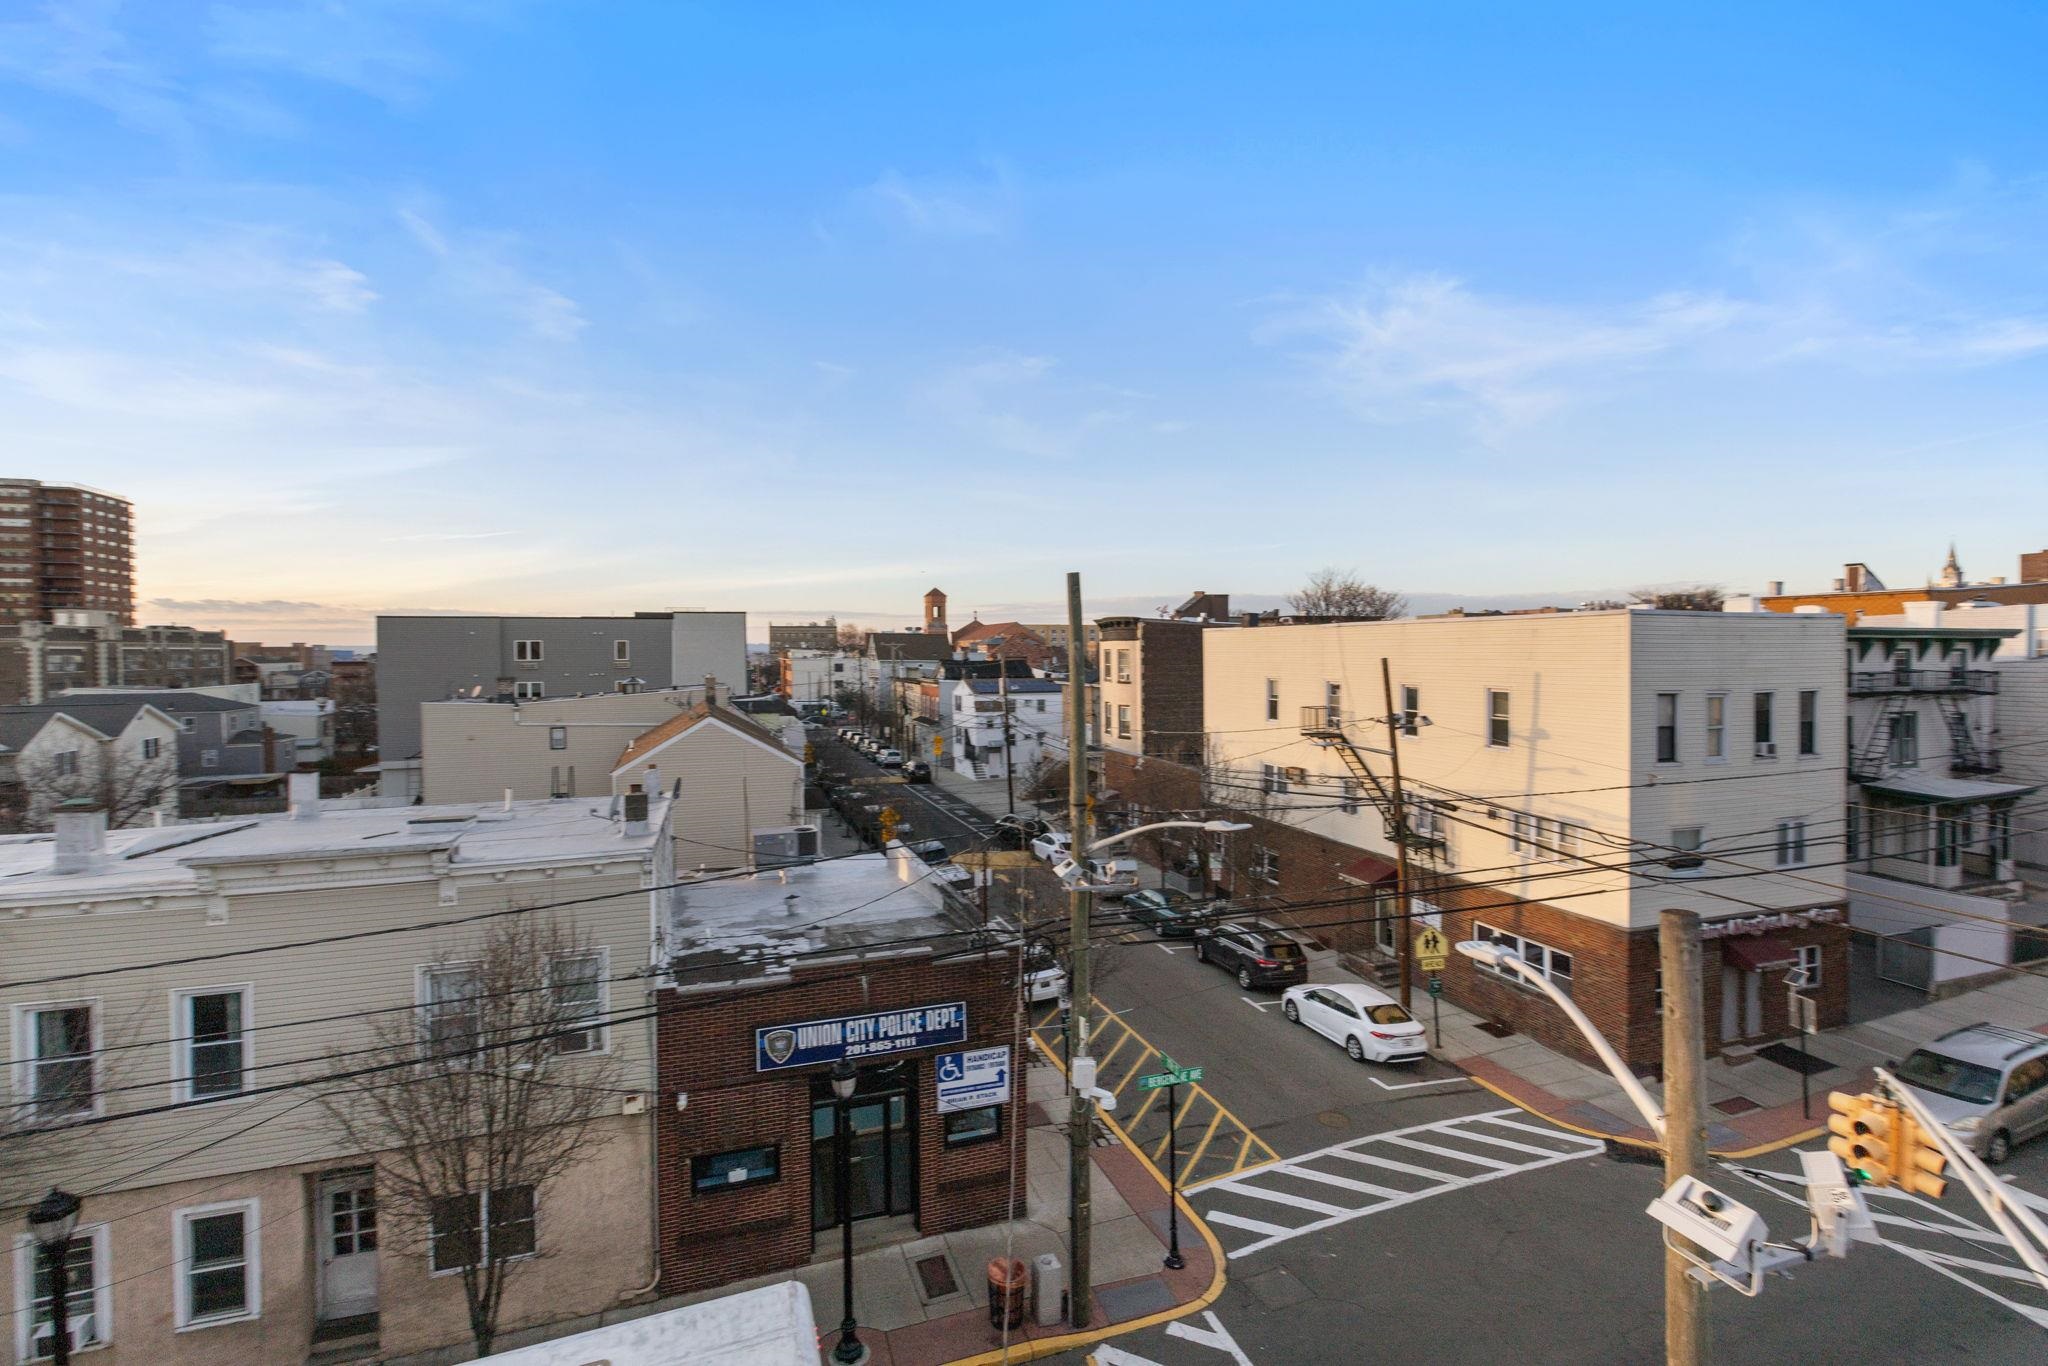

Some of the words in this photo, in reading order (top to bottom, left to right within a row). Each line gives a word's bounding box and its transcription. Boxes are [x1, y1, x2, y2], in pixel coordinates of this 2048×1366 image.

[798, 1022, 842, 1050] UNION
[846, 1017, 876, 1043] CITY
[878, 1012, 923, 1037] POLICE
[925, 1007, 960, 1031] DEPT.
[845, 1036, 917, 1056] 201-865-1111
[967, 1050, 1007, 1063] HANDICAP
[1189, 1069, 1203, 1081] AVE
[976, 1091, 997, 1100] STACK
